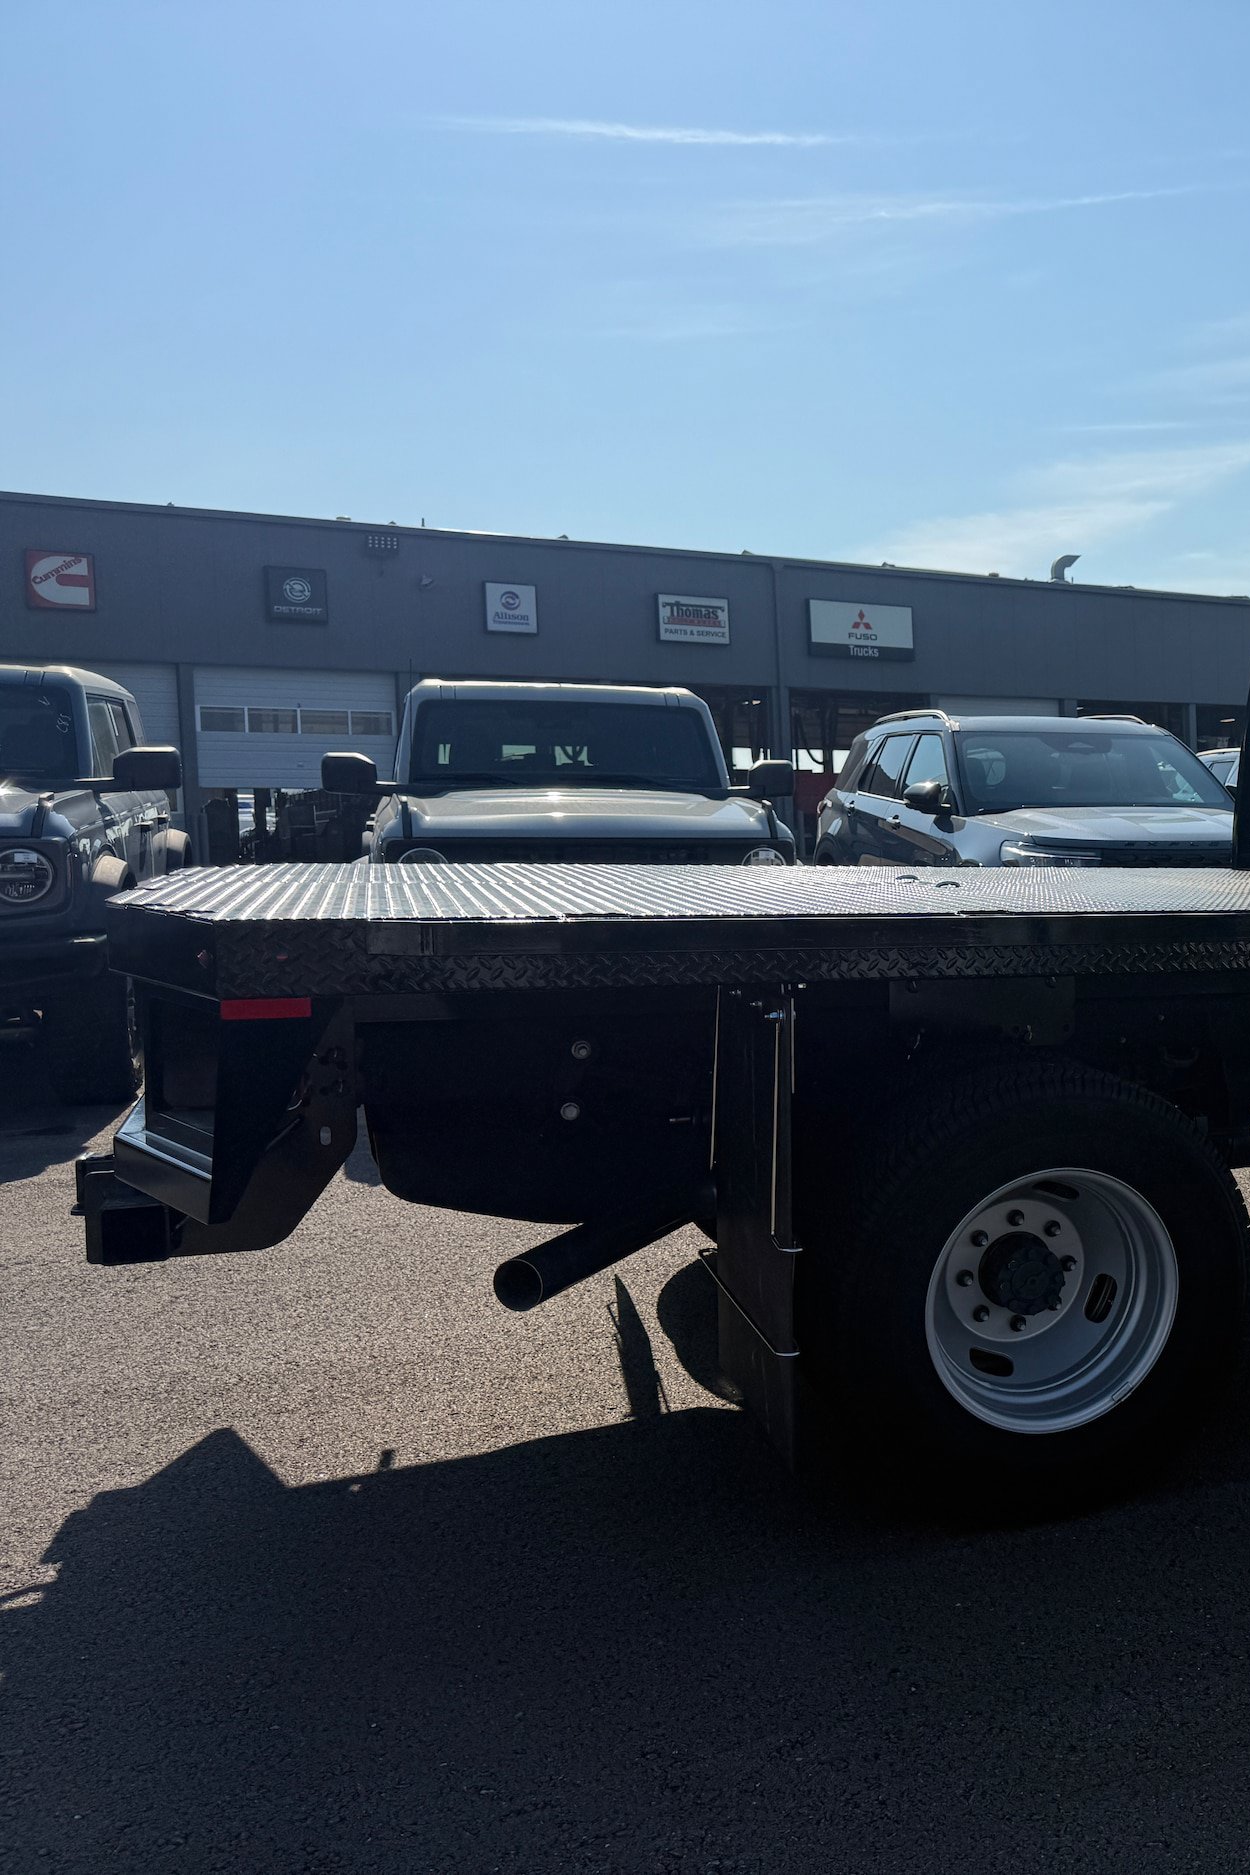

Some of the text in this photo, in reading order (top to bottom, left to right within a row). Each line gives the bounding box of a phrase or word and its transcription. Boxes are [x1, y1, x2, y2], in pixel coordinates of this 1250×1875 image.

[32, 558, 83, 584] Cummins
[274, 605, 322, 615] DETROIT
[666, 603, 719, 620] Thomas
[494, 611, 529, 621] Allison
[664, 628, 688, 636] PARTS
[696, 630, 727, 638] SERVICE
[848, 632, 878, 641] FUSO
[848, 645, 879, 657] Trucks
